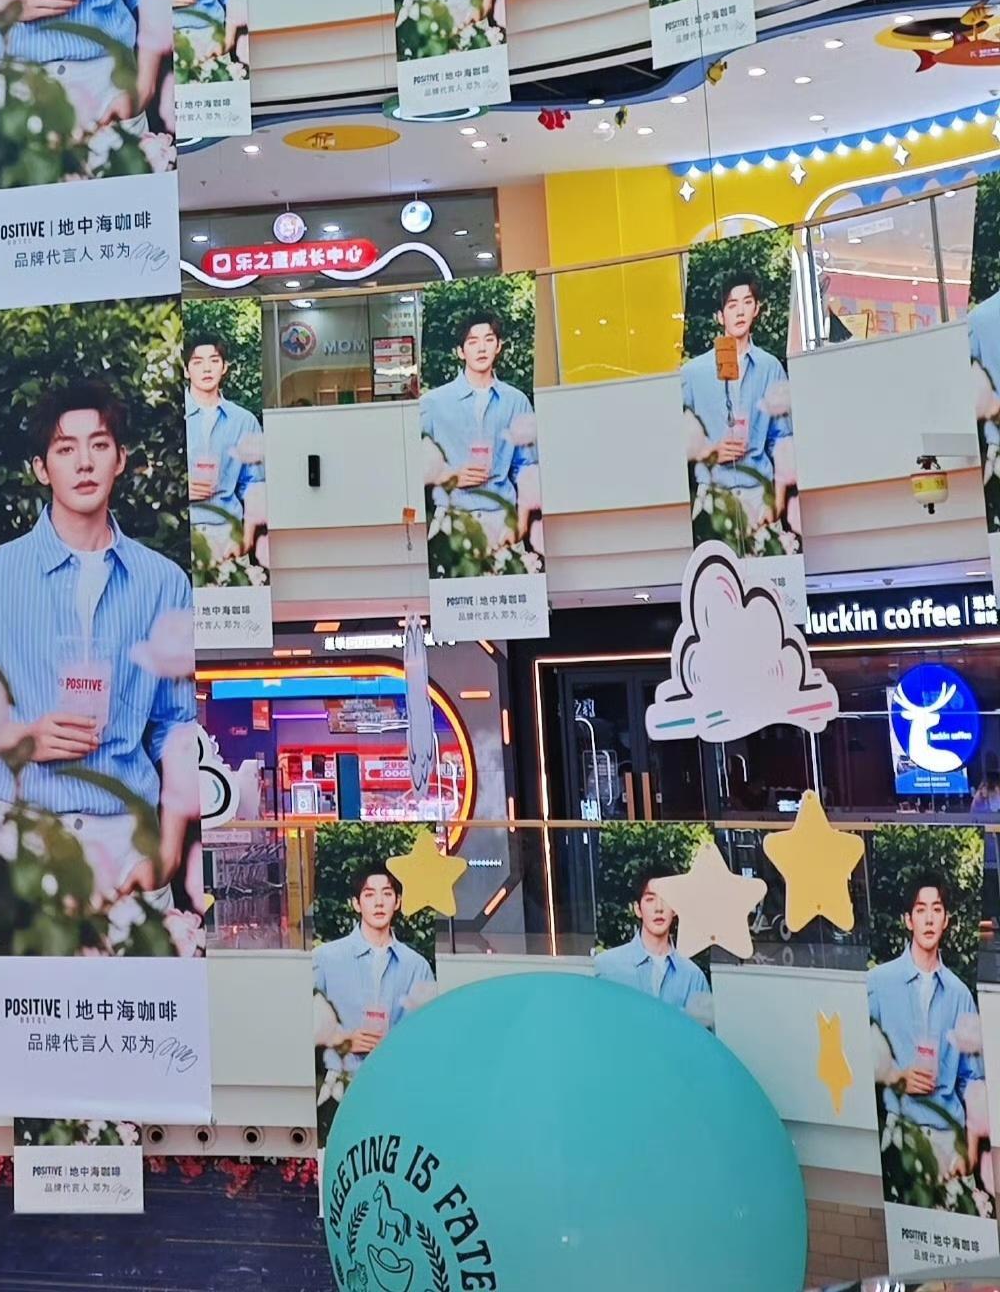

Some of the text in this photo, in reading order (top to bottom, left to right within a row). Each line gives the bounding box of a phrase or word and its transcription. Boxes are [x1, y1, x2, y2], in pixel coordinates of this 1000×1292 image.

[58, 211, 151, 237] 地中海咖啡
[14, 244, 93, 268] 品牌代言人
[100, 243, 130, 259] 邓为
[805, 598, 962, 635] luckin coffee
[66, 678, 103, 691] POSITIVE
[5, 998, 177, 1022] POSITIVE 地中海咖啡
[28, 1034, 154, 1053] 品牌代言人 邓为
[329, 1135, 497, 1292] MEETING IS FATE
